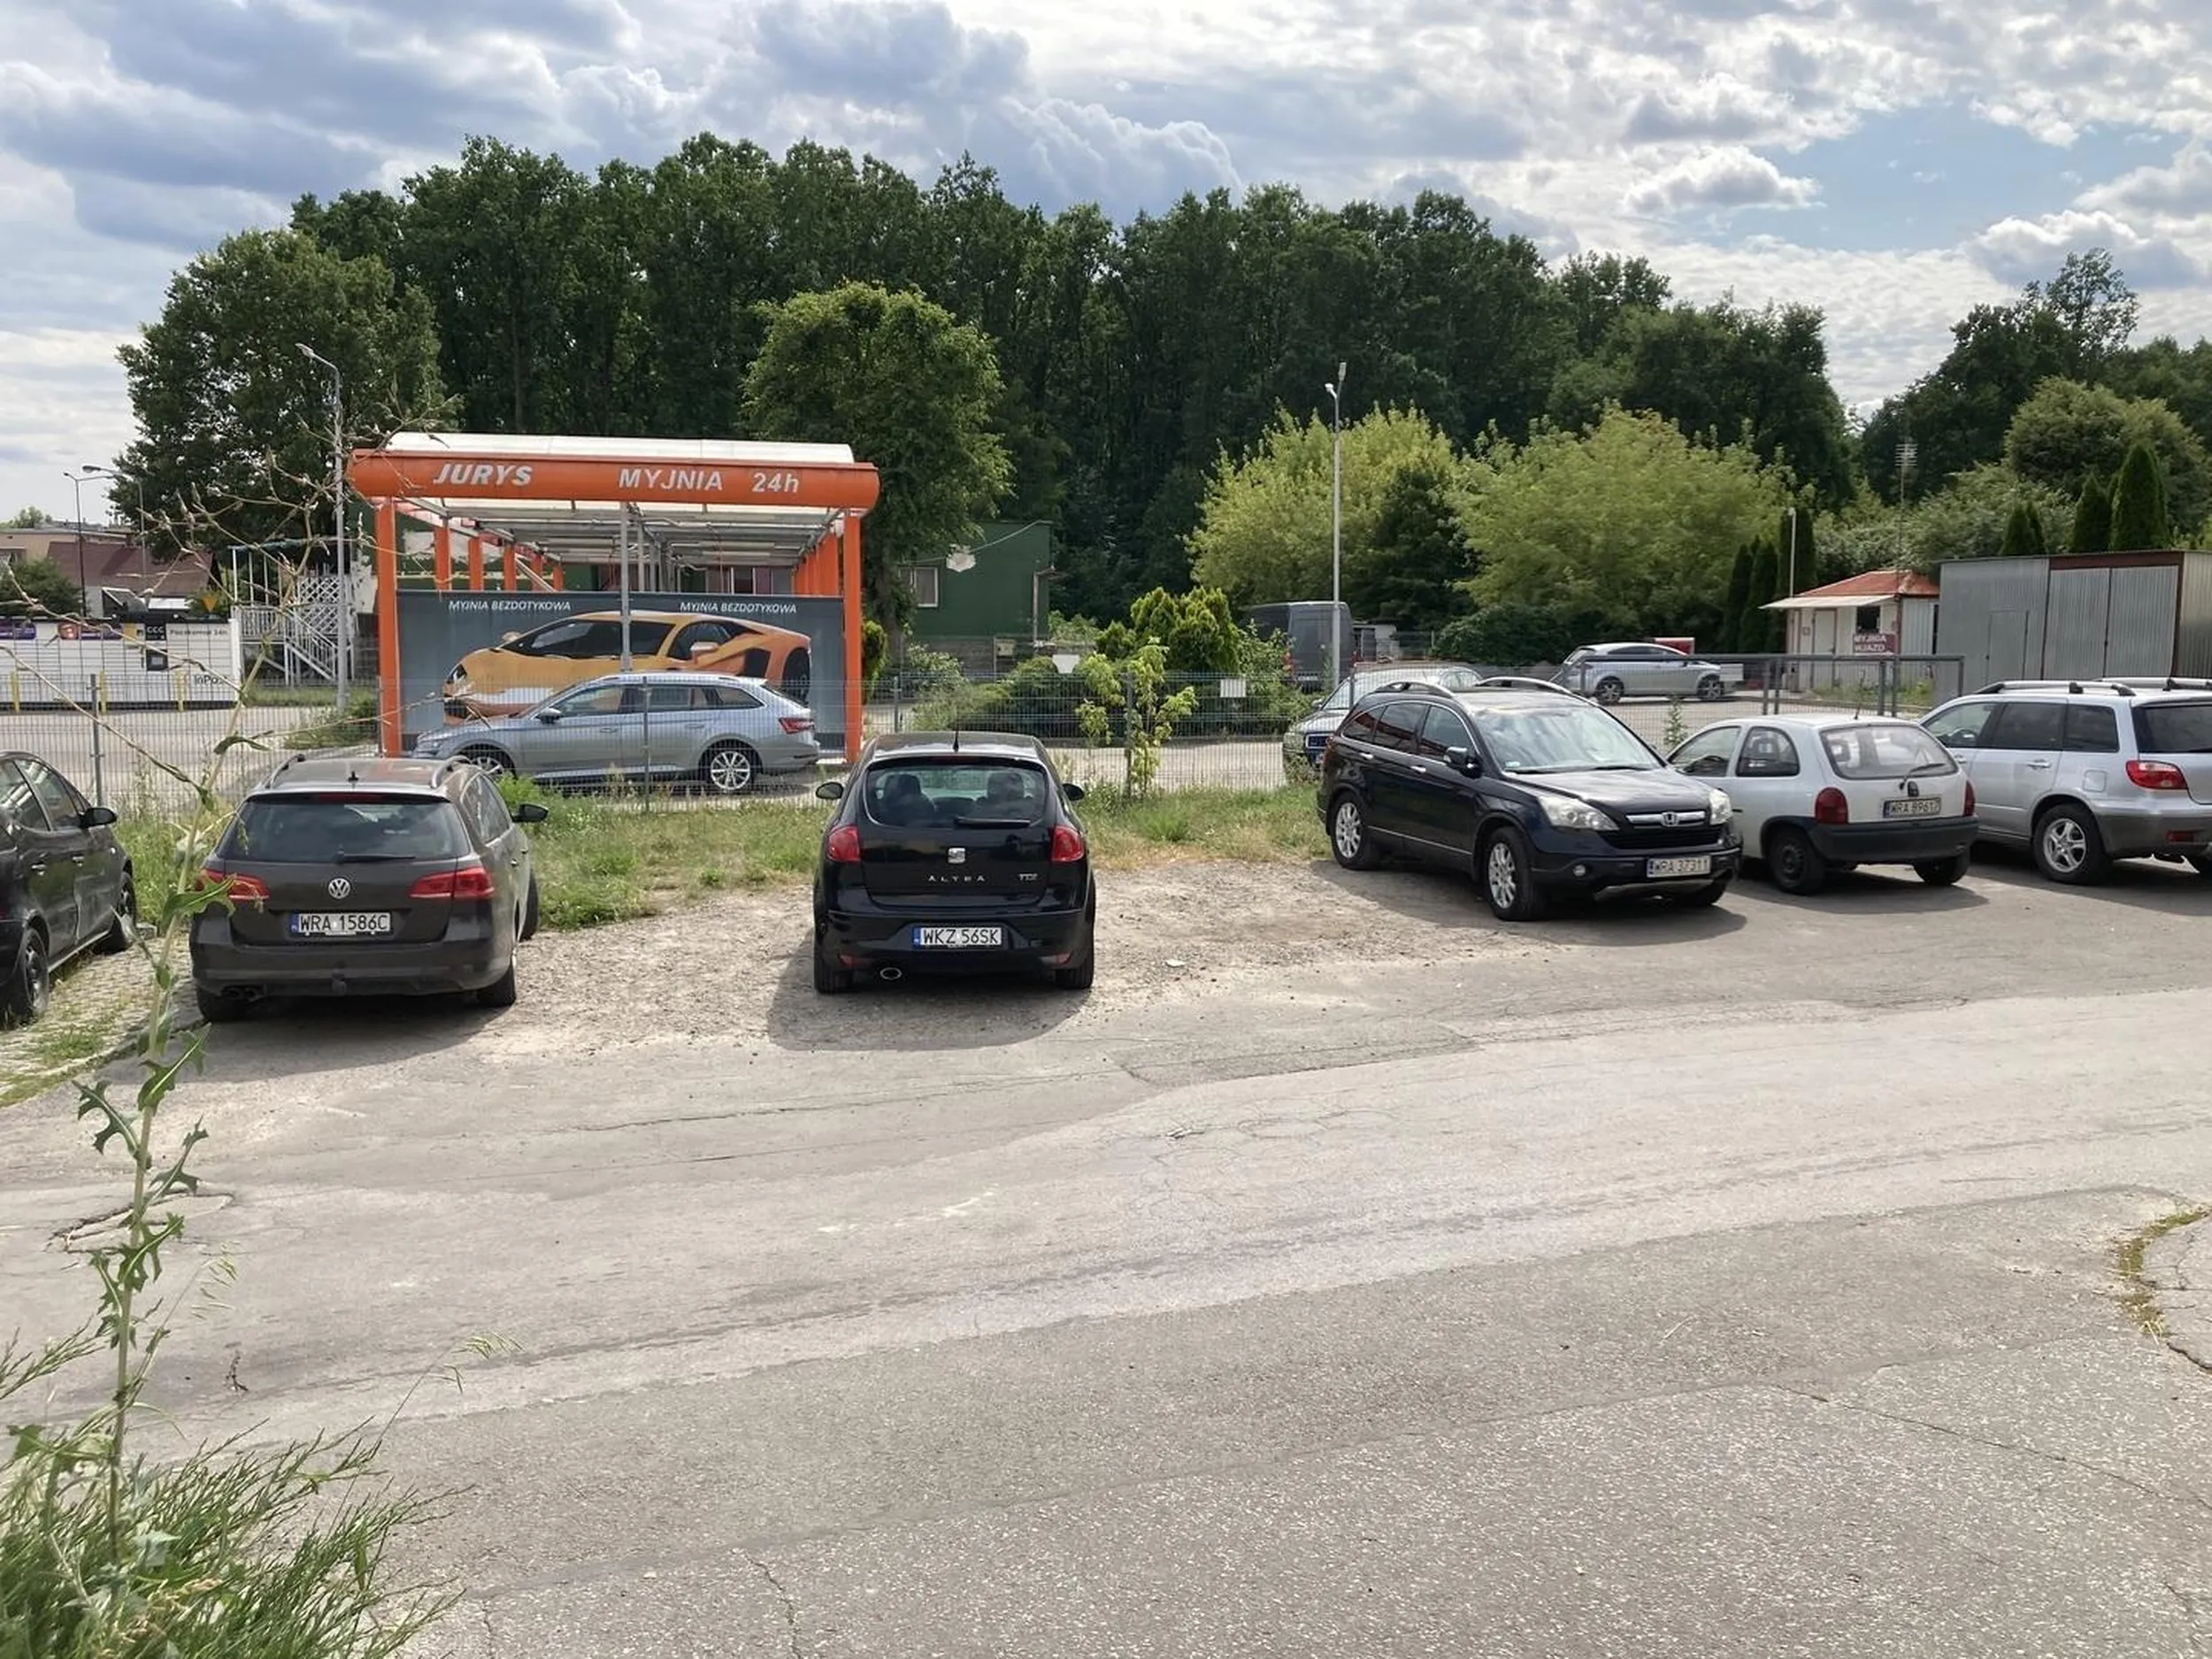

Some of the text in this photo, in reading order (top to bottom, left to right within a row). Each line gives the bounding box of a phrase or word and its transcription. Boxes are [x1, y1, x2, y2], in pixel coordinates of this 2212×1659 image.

[432, 463, 800, 493] JURYS MYJNIA 24h
[449, 600, 572, 612] MYJNIA BEZDOTYKOWA
[680, 602, 797, 615] MYJNIA BEZDOTYKOWA
[146, 626, 165, 634] CCC
[300, 914, 388, 931] WRA 1586C
[923, 929, 998, 945] WKZ 56SK
